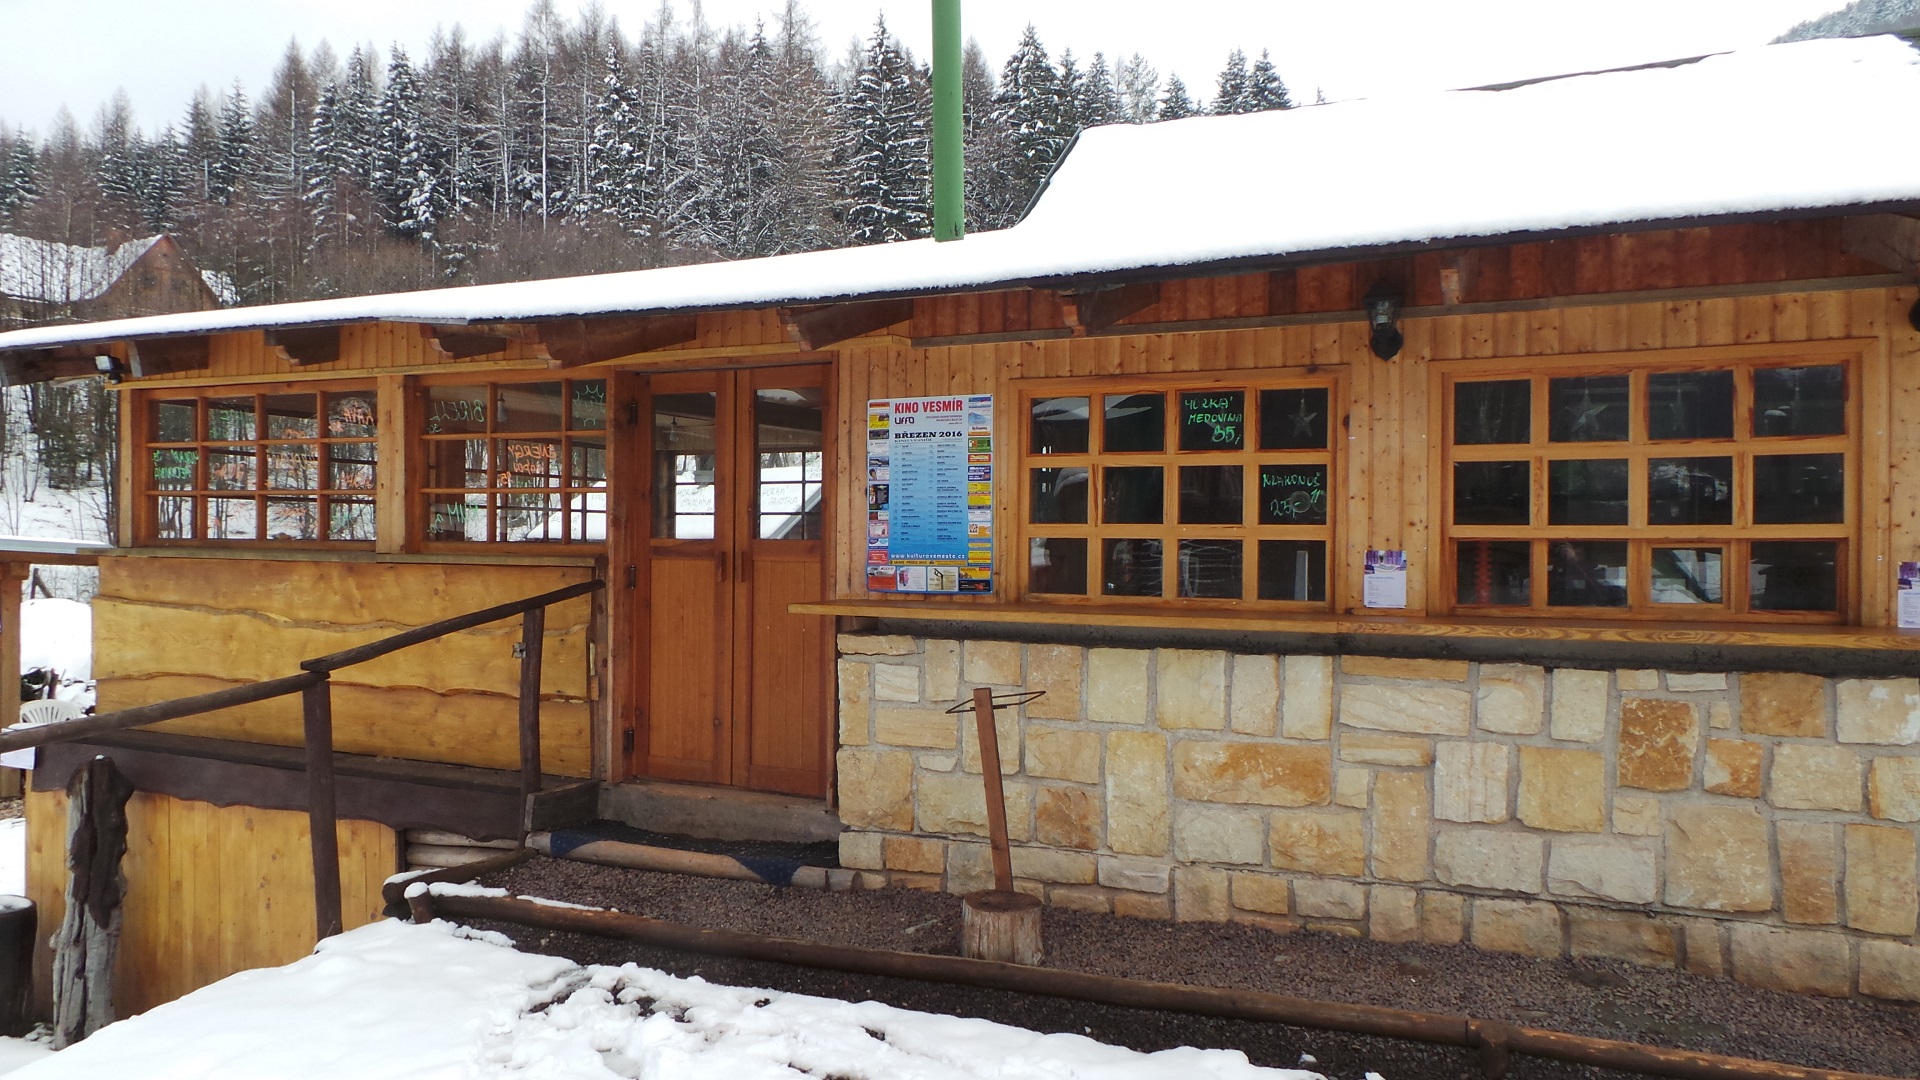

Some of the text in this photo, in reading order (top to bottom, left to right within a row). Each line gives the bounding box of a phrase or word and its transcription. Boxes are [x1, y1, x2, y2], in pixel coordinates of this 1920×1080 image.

[894, 402, 919, 414] KINO
[922, 398, 963, 413] VESMÍR
[1187, 413, 1242, 425] MEDOVINA
[894, 430, 963, 439] BŘEZEN 2016
[1262, 472, 1321, 488] KRAKONOŠ
